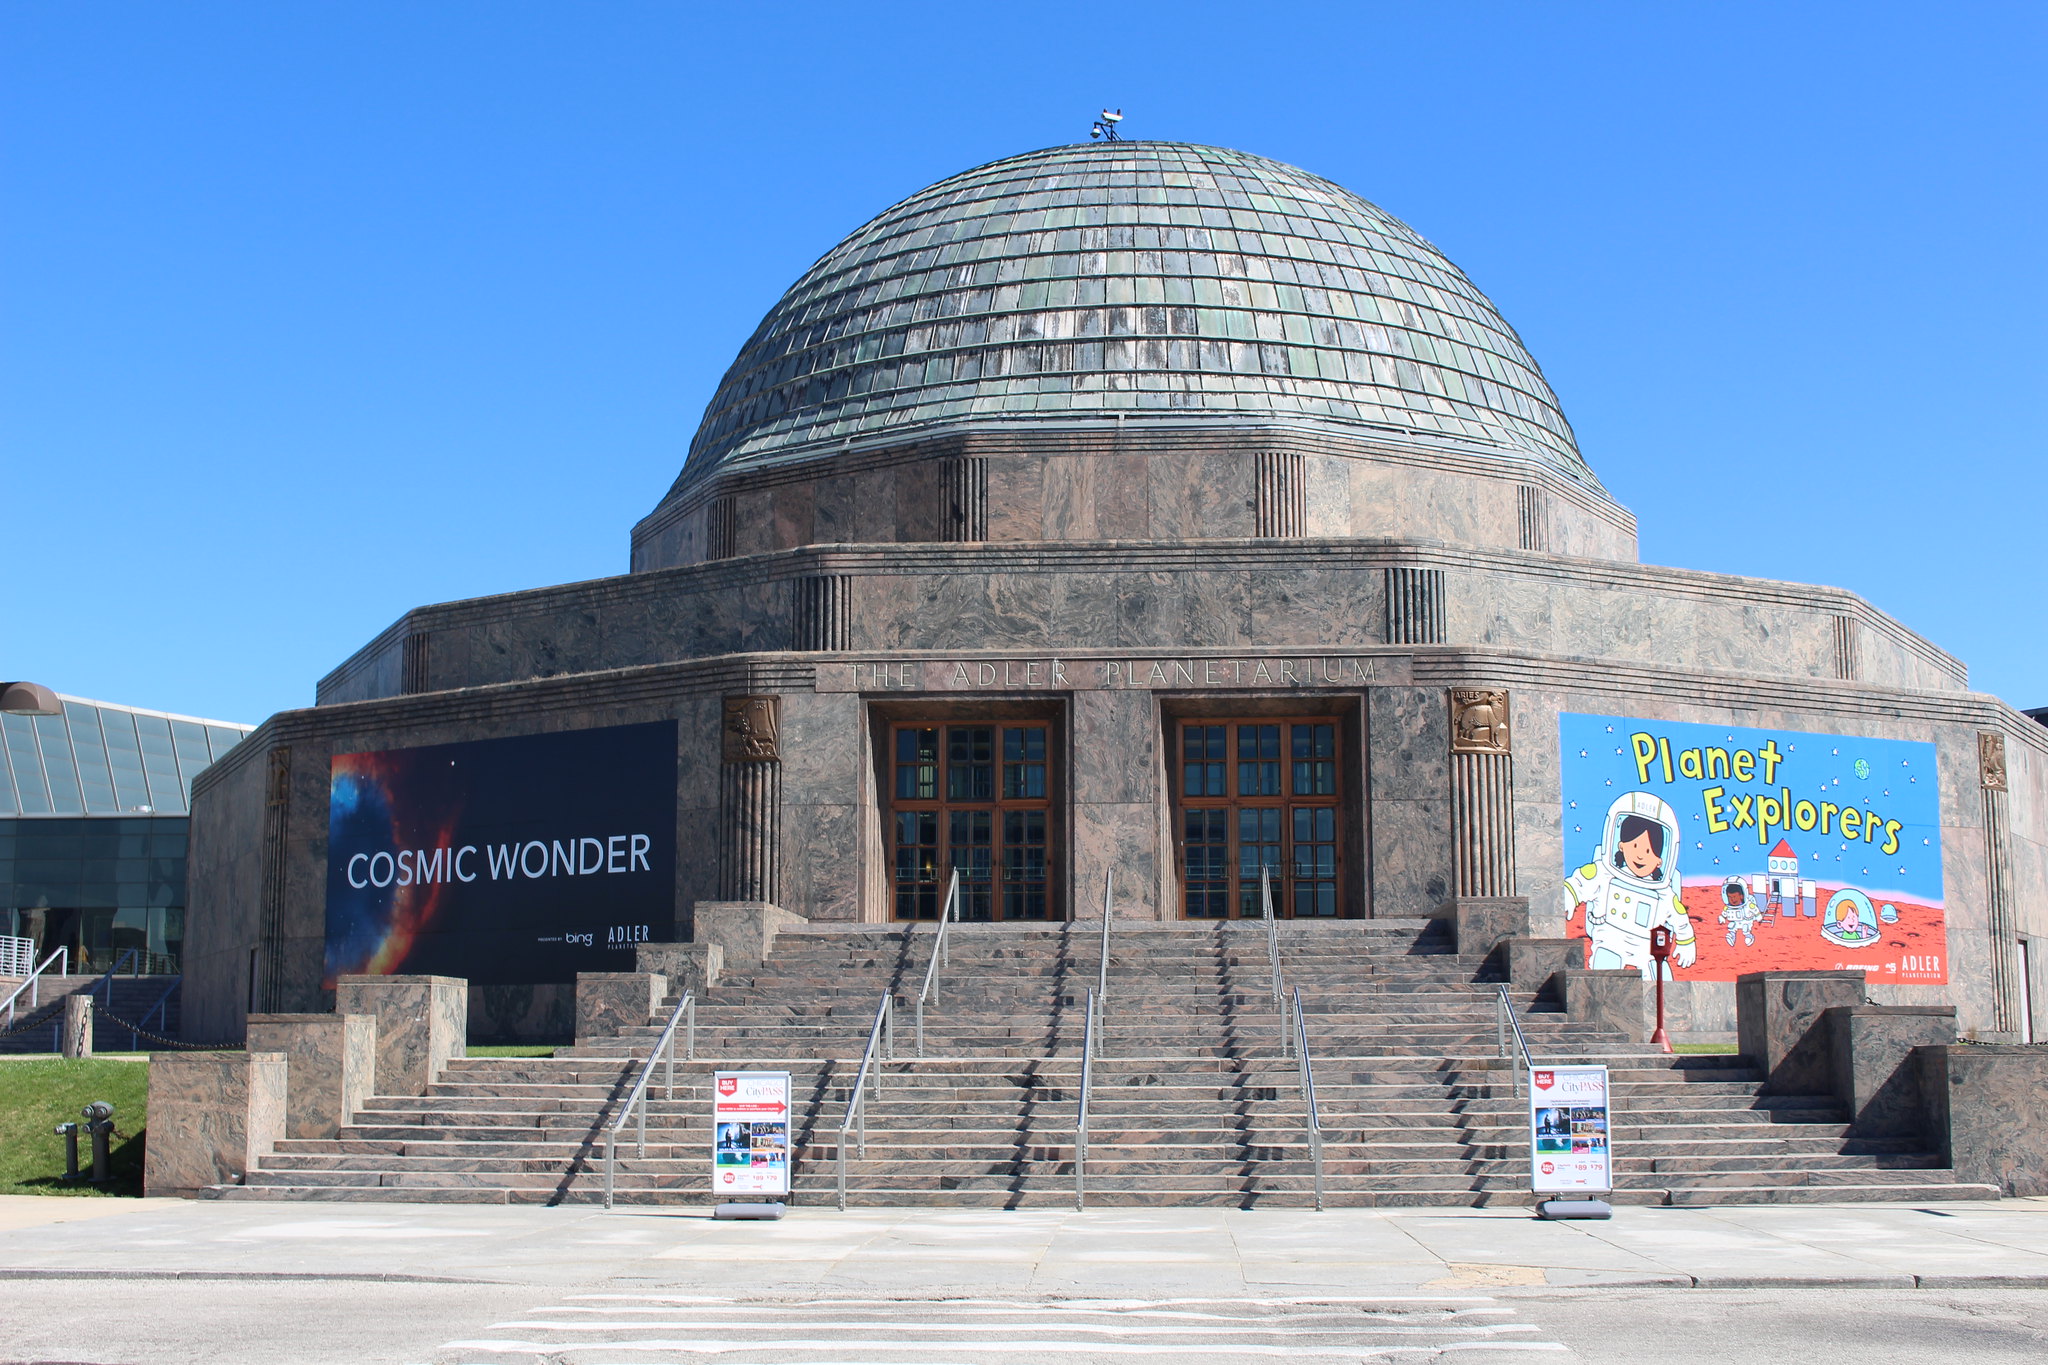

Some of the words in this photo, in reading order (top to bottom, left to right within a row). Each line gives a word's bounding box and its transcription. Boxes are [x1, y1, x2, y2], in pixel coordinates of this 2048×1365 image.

[846, 663, 916, 687] THE
[951, 661, 1071, 687] ADLER
[1105, 658, 1377, 685] PLANETARIUM
[1629, 731, 1784, 786] Planet
[1702, 786, 1903, 855] Explorers
[347, 845, 477, 890] COSMIC
[487, 833, 651, 880] WONDER
[565, 932, 593, 946] bing
[607, 925, 649, 943] ADLER
[1901, 955, 1940, 971] ADLER
[746, 1086, 783, 1097] CityPASS
[1561, 1081, 1605, 1094] CityPASS
